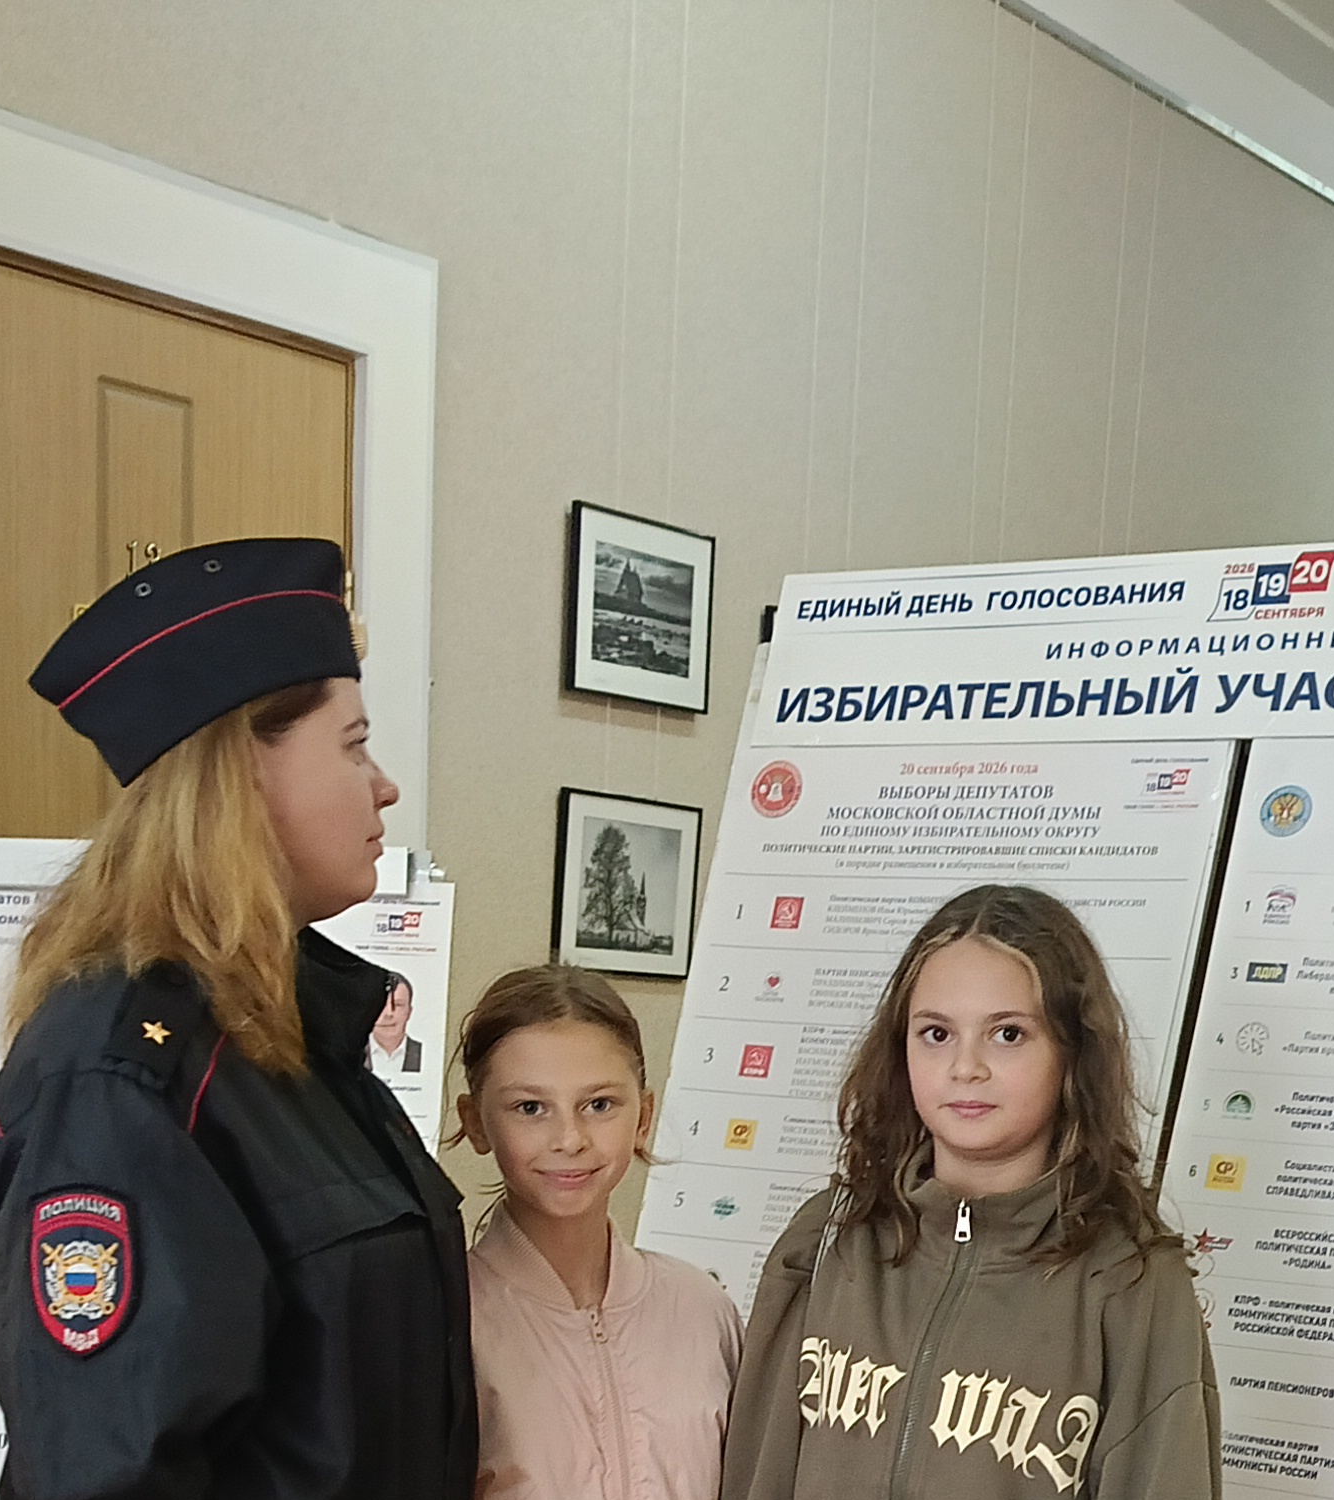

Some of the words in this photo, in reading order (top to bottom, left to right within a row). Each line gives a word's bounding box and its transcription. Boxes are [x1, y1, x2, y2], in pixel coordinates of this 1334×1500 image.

[1224, 563, 1254, 574] 2026
[1223, 589, 1249, 611] 18
[1257, 573, 1287, 597] 19
[1292, 560, 1329, 585] 20
[797, 592, 902, 621] ЕДИНЫЙ
[905, 592, 974, 618] ДЕНЬ
[986, 580, 1186, 611] ГОЛОСОВАНИЯ
[1255, 607, 1324, 620] СЕНТЯБРЯ
[775, 667, 1201, 723] ИЗБИРАТЕЛЬНЫЙ
[899, 763, 914, 776] 20
[916, 764, 975, 777] сентября
[978, 762, 1008, 774] 2026
[1010, 763, 1038, 776] года
[878, 786, 951, 800] ВЫБОРЫ
[953, 785, 1054, 801] ДЕПУТАТОВ
[826, 804, 940, 820] МОСКОВСКОЙ
[942, 803, 1046, 821] ОБЛАСТНОЙ
[1047, 806, 1101, 822] ДУМЫ
[820, 826, 841, 838] ПО
[843, 825, 910, 839] ЕДИНОМУ
[912, 825, 1043, 839] ИЗБИРАТЕЛЬНОМУ
[1044, 825, 1101, 839] ОКРУГУ
[736, 904, 743, 919] 1
[719, 976, 730, 991] 2
[704, 1048, 714, 1063] 3
[689, 1120, 699, 1136] 4
[674, 1192, 685, 1207] 5
[39, 1197, 121, 1222] ПОЛИЦИЯ
[1255, 1240, 1327, 1255] ПОЛИТИЧЕСКАЯ
[1228, 1307, 1328, 1327] КОММУНИСТИЧЕСКАЯ
[1233, 1321, 1295, 1338] РОССИЙСКОЙ
[1230, 1377, 1266, 1390] ПАРТИЯ
[1222, 1443, 1298, 1464] УНИСТИЧЕСКАЯ
[1222, 1457, 1277, 1475] ММУНИСТЫ
[1279, 1466, 1318, 1481] РОССИИ
